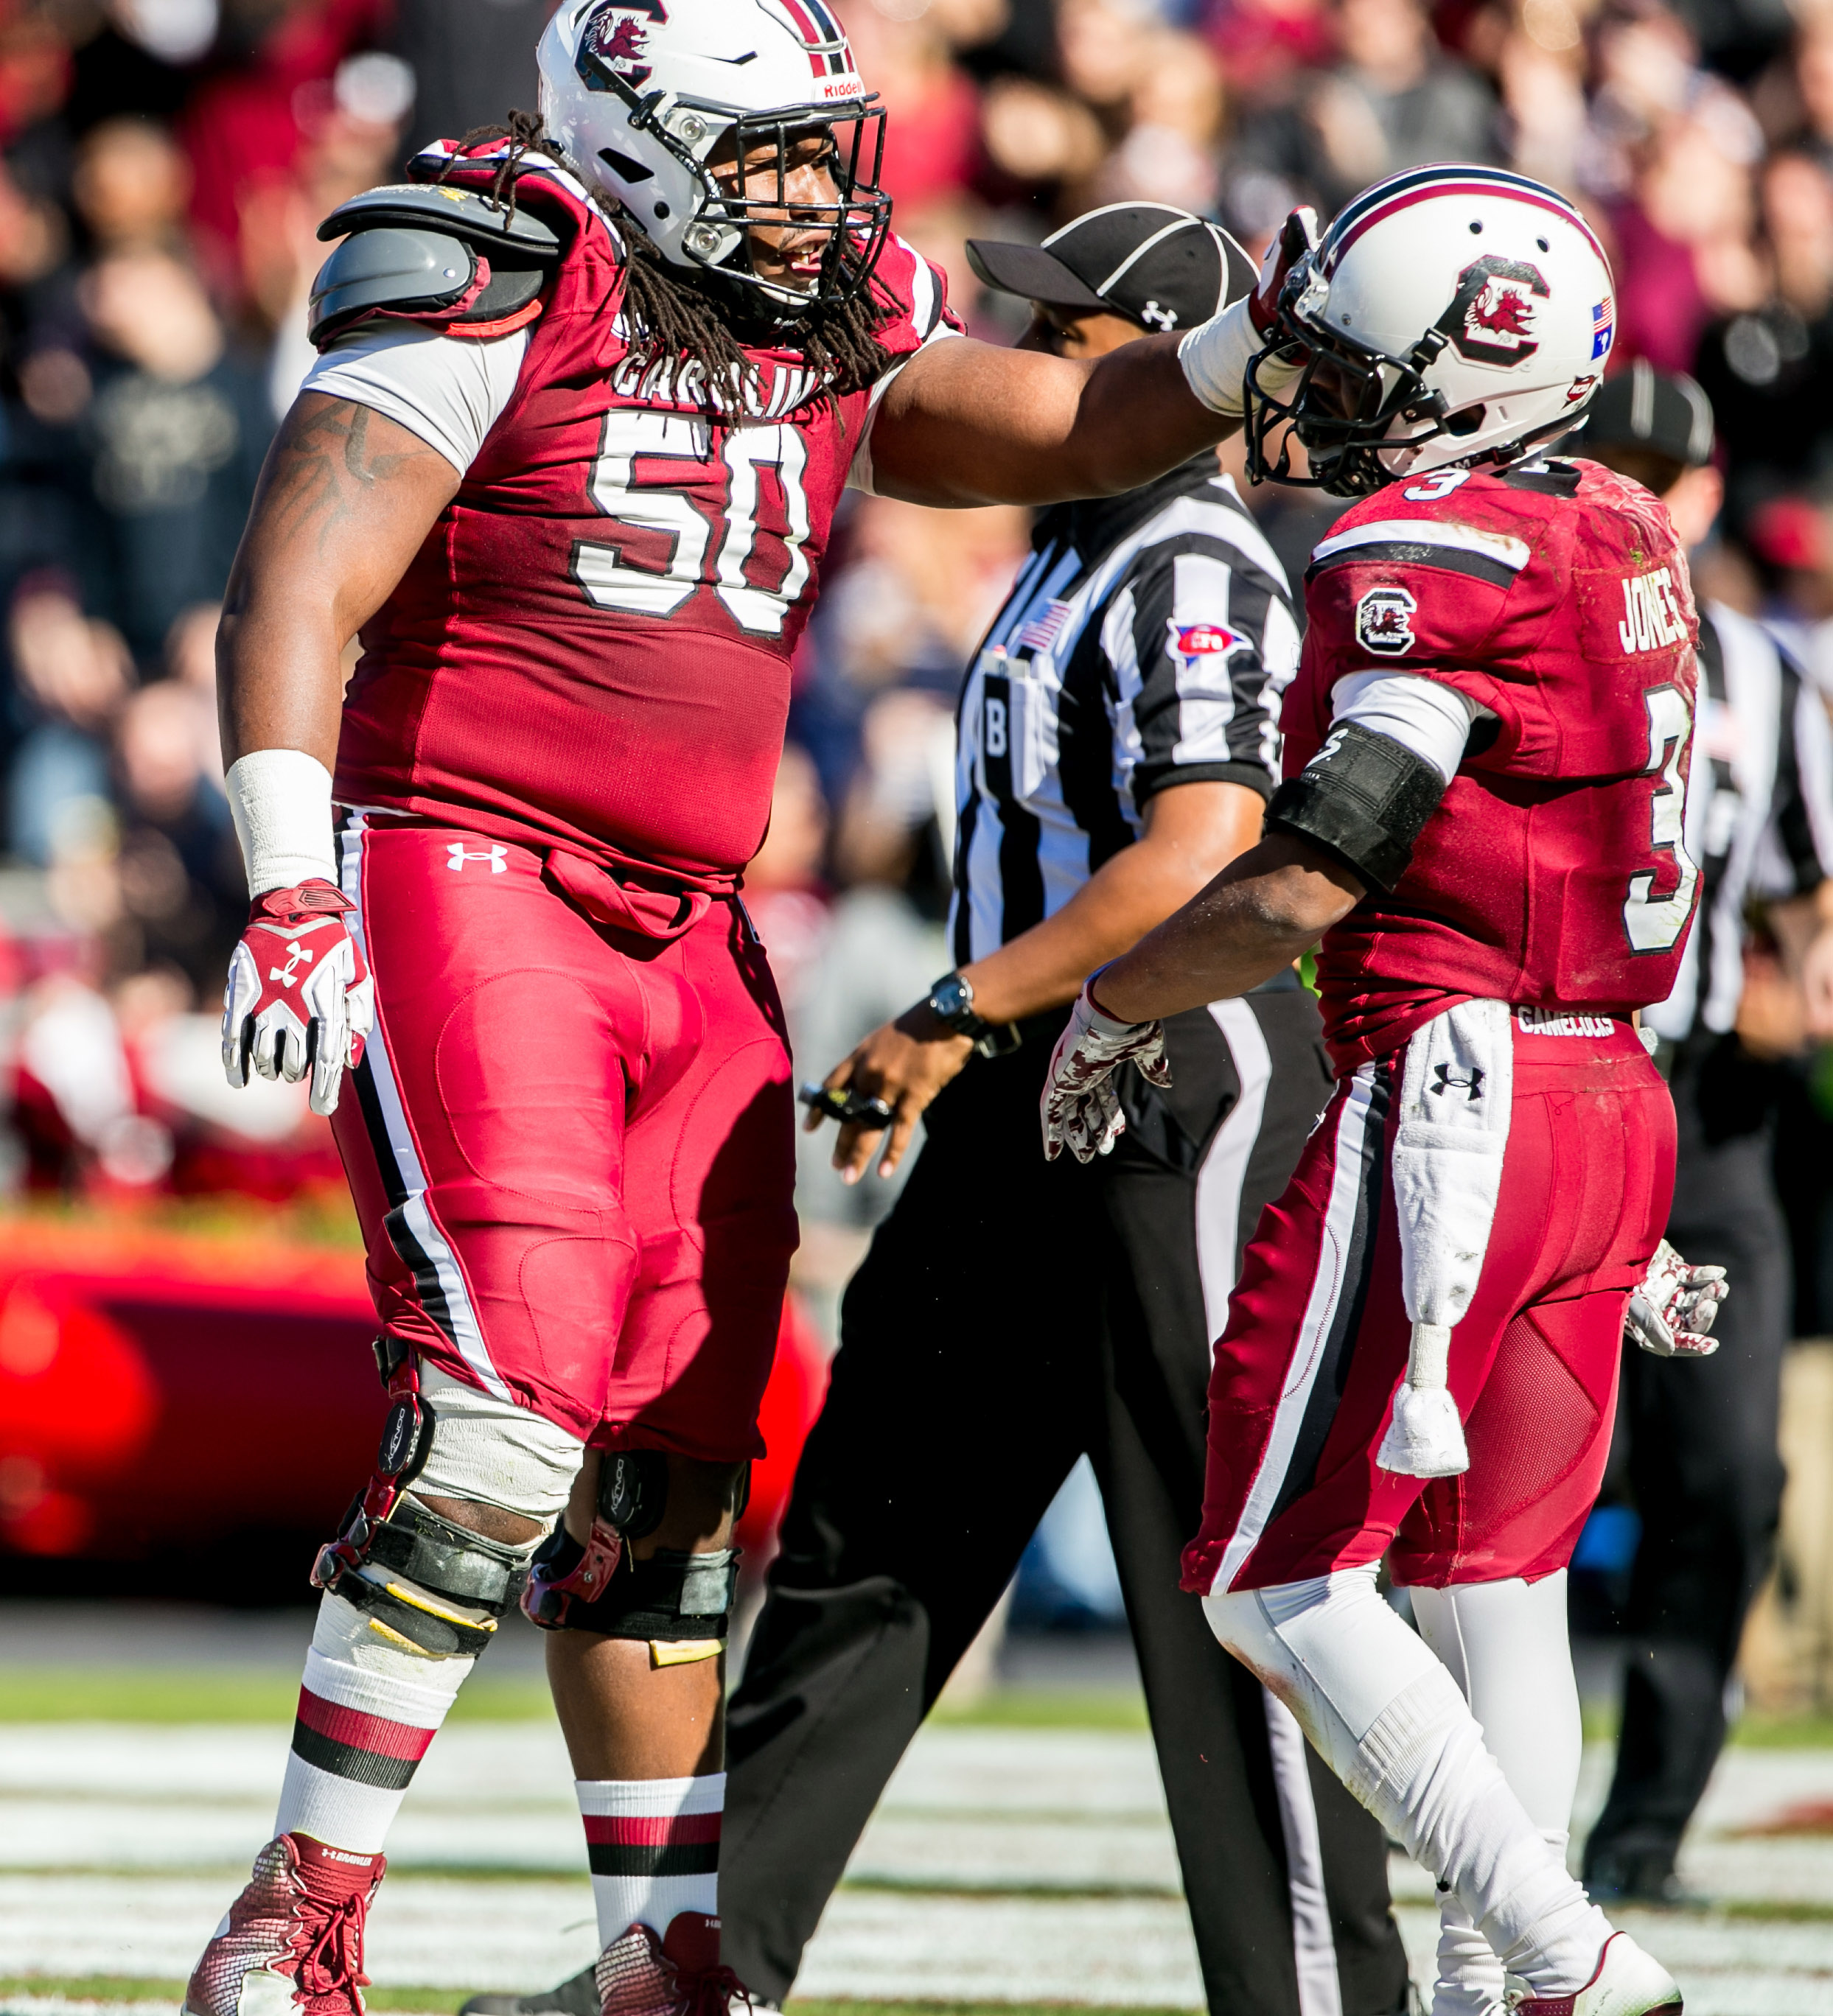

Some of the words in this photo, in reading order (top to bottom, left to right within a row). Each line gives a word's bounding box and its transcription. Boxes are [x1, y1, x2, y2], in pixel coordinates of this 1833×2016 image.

[824, 80, 862, 98] Riddell
[1403, 467, 1471, 502] 3
[568, 406, 811, 640] 50
[1618, 567, 1688, 654] JONES
[986, 697, 1008, 757] B
[1620, 682, 1699, 956] 3
[388, 1407, 405, 1466] DONJOY
[610, 1458, 625, 1516] DONJOY
[335, 1852, 373, 1866] BRAWLER
